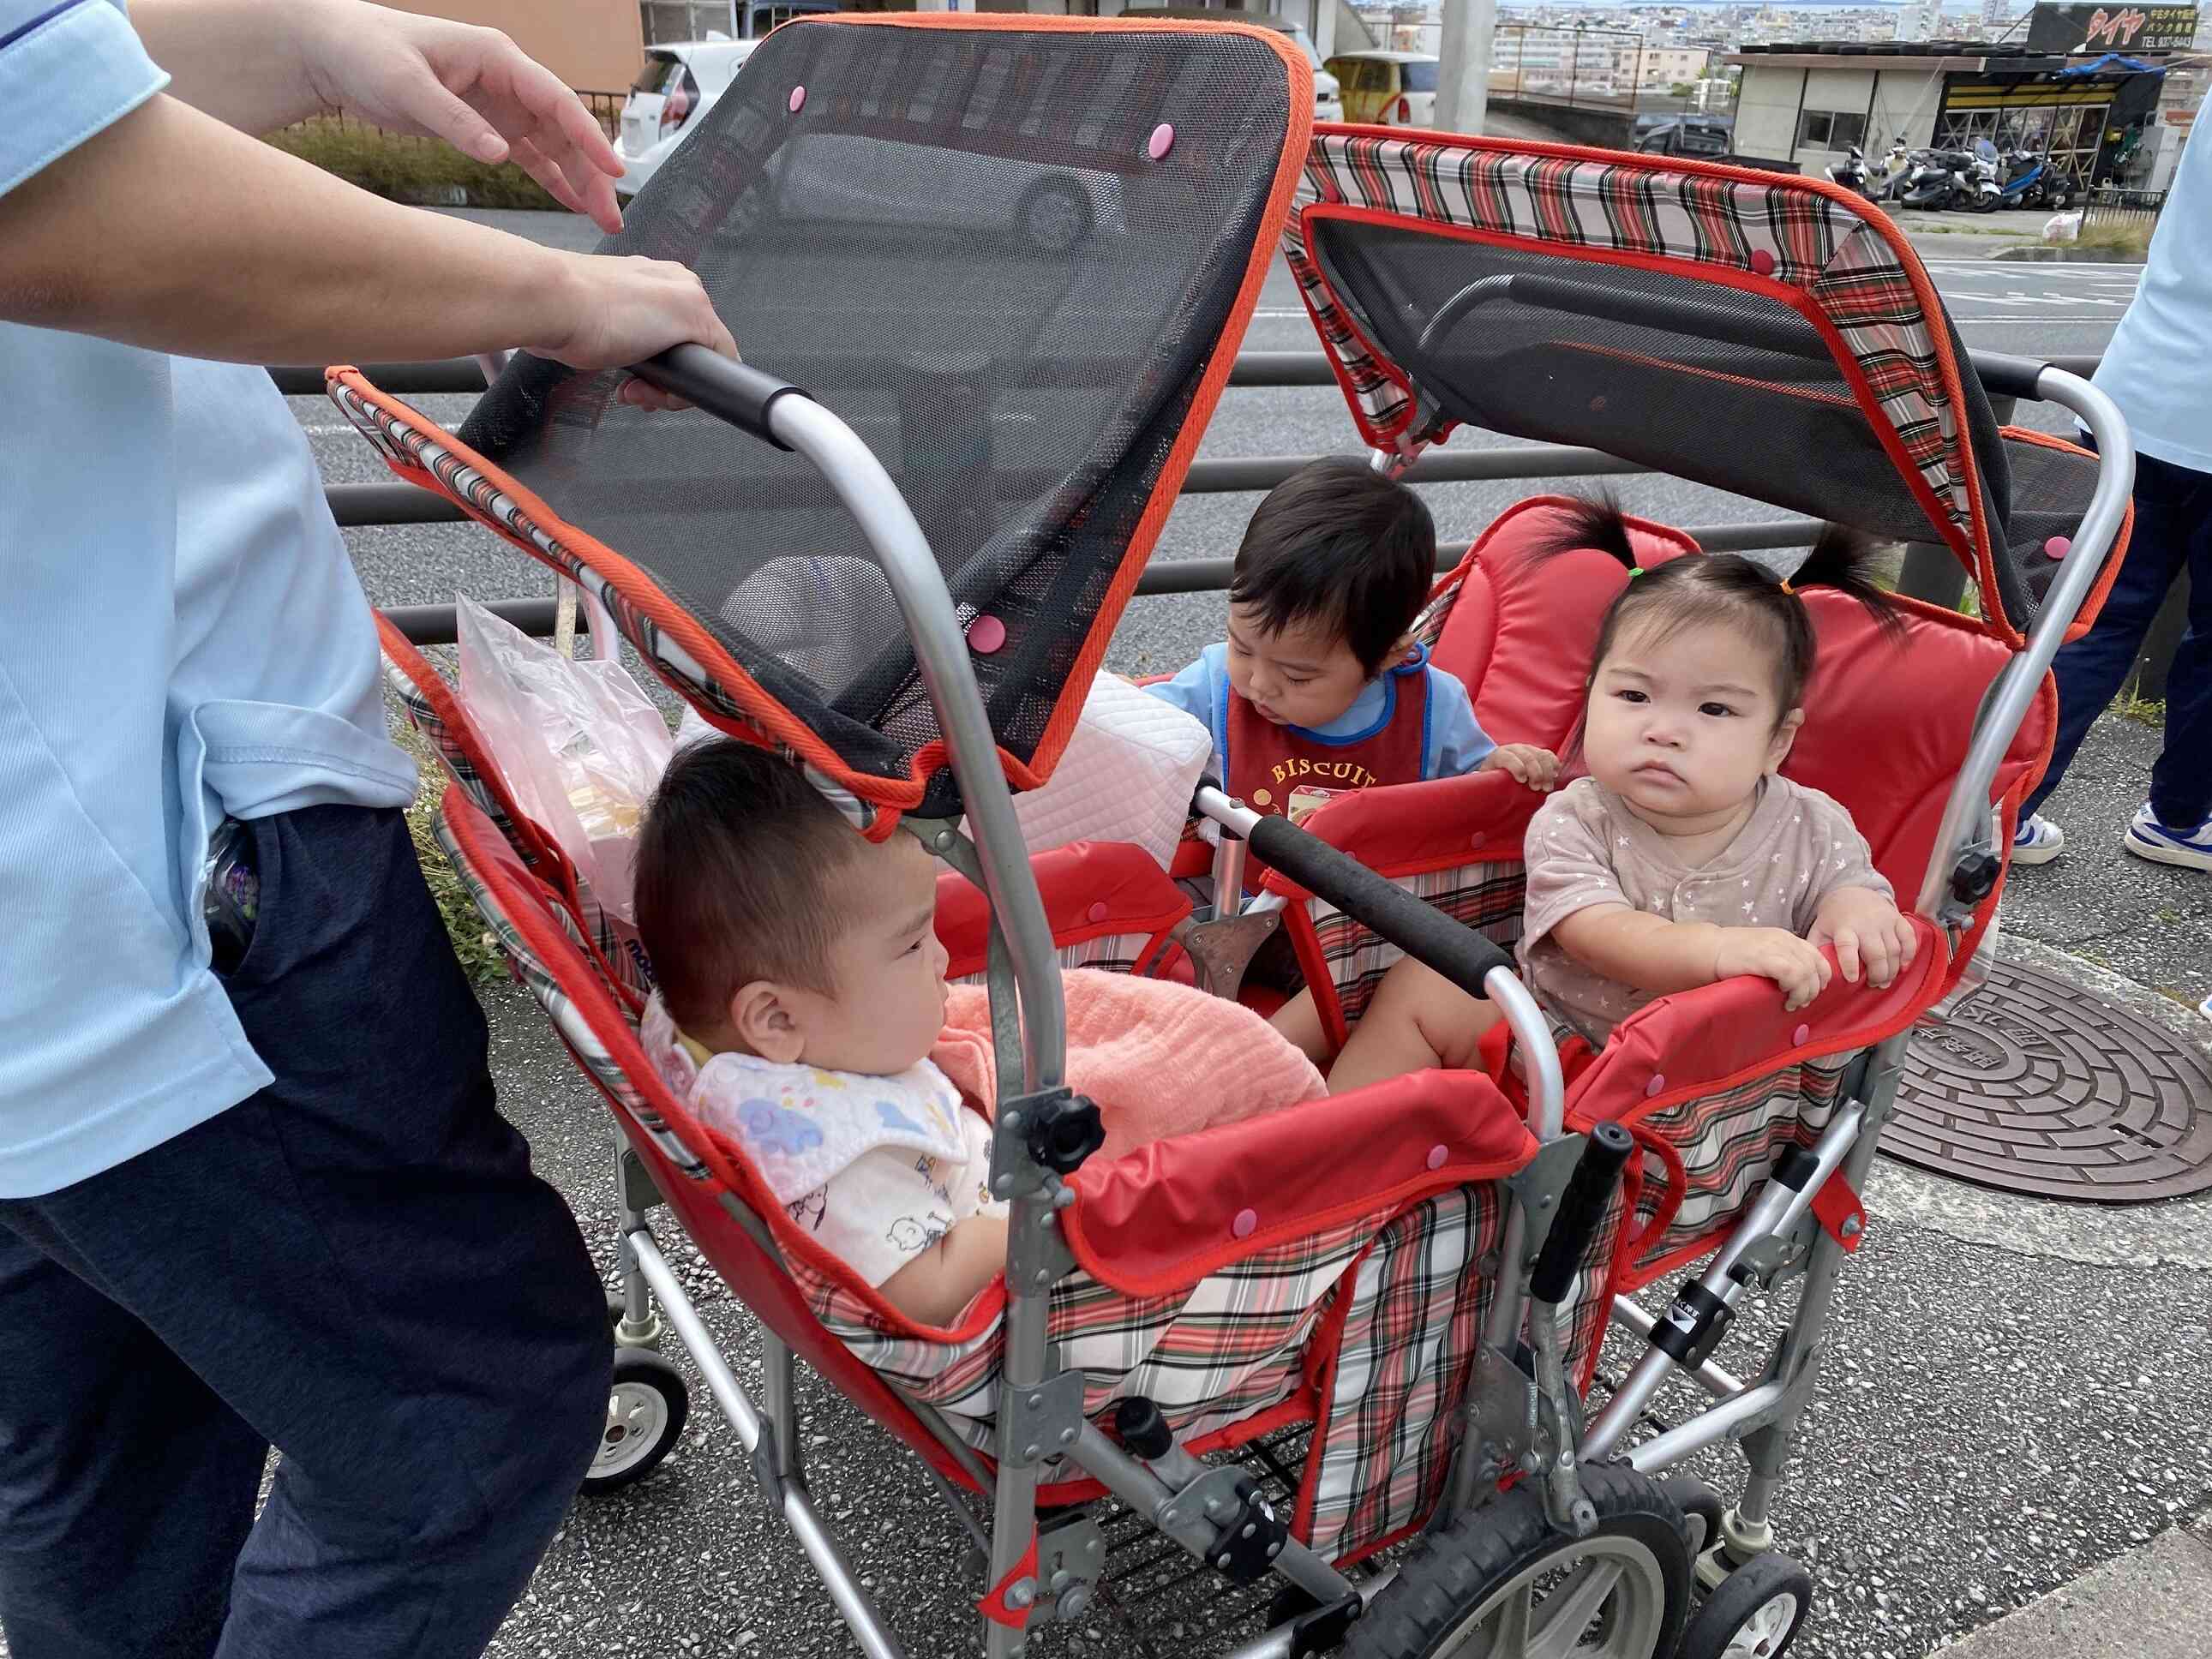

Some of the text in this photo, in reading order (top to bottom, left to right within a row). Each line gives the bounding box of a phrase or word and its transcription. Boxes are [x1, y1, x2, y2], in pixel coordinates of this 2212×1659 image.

[2086, 8, 2146, 45] タイヤ
[2142, 36, 2156, 48] TEL
[1271, 758, 1377, 788] BISCUIT
